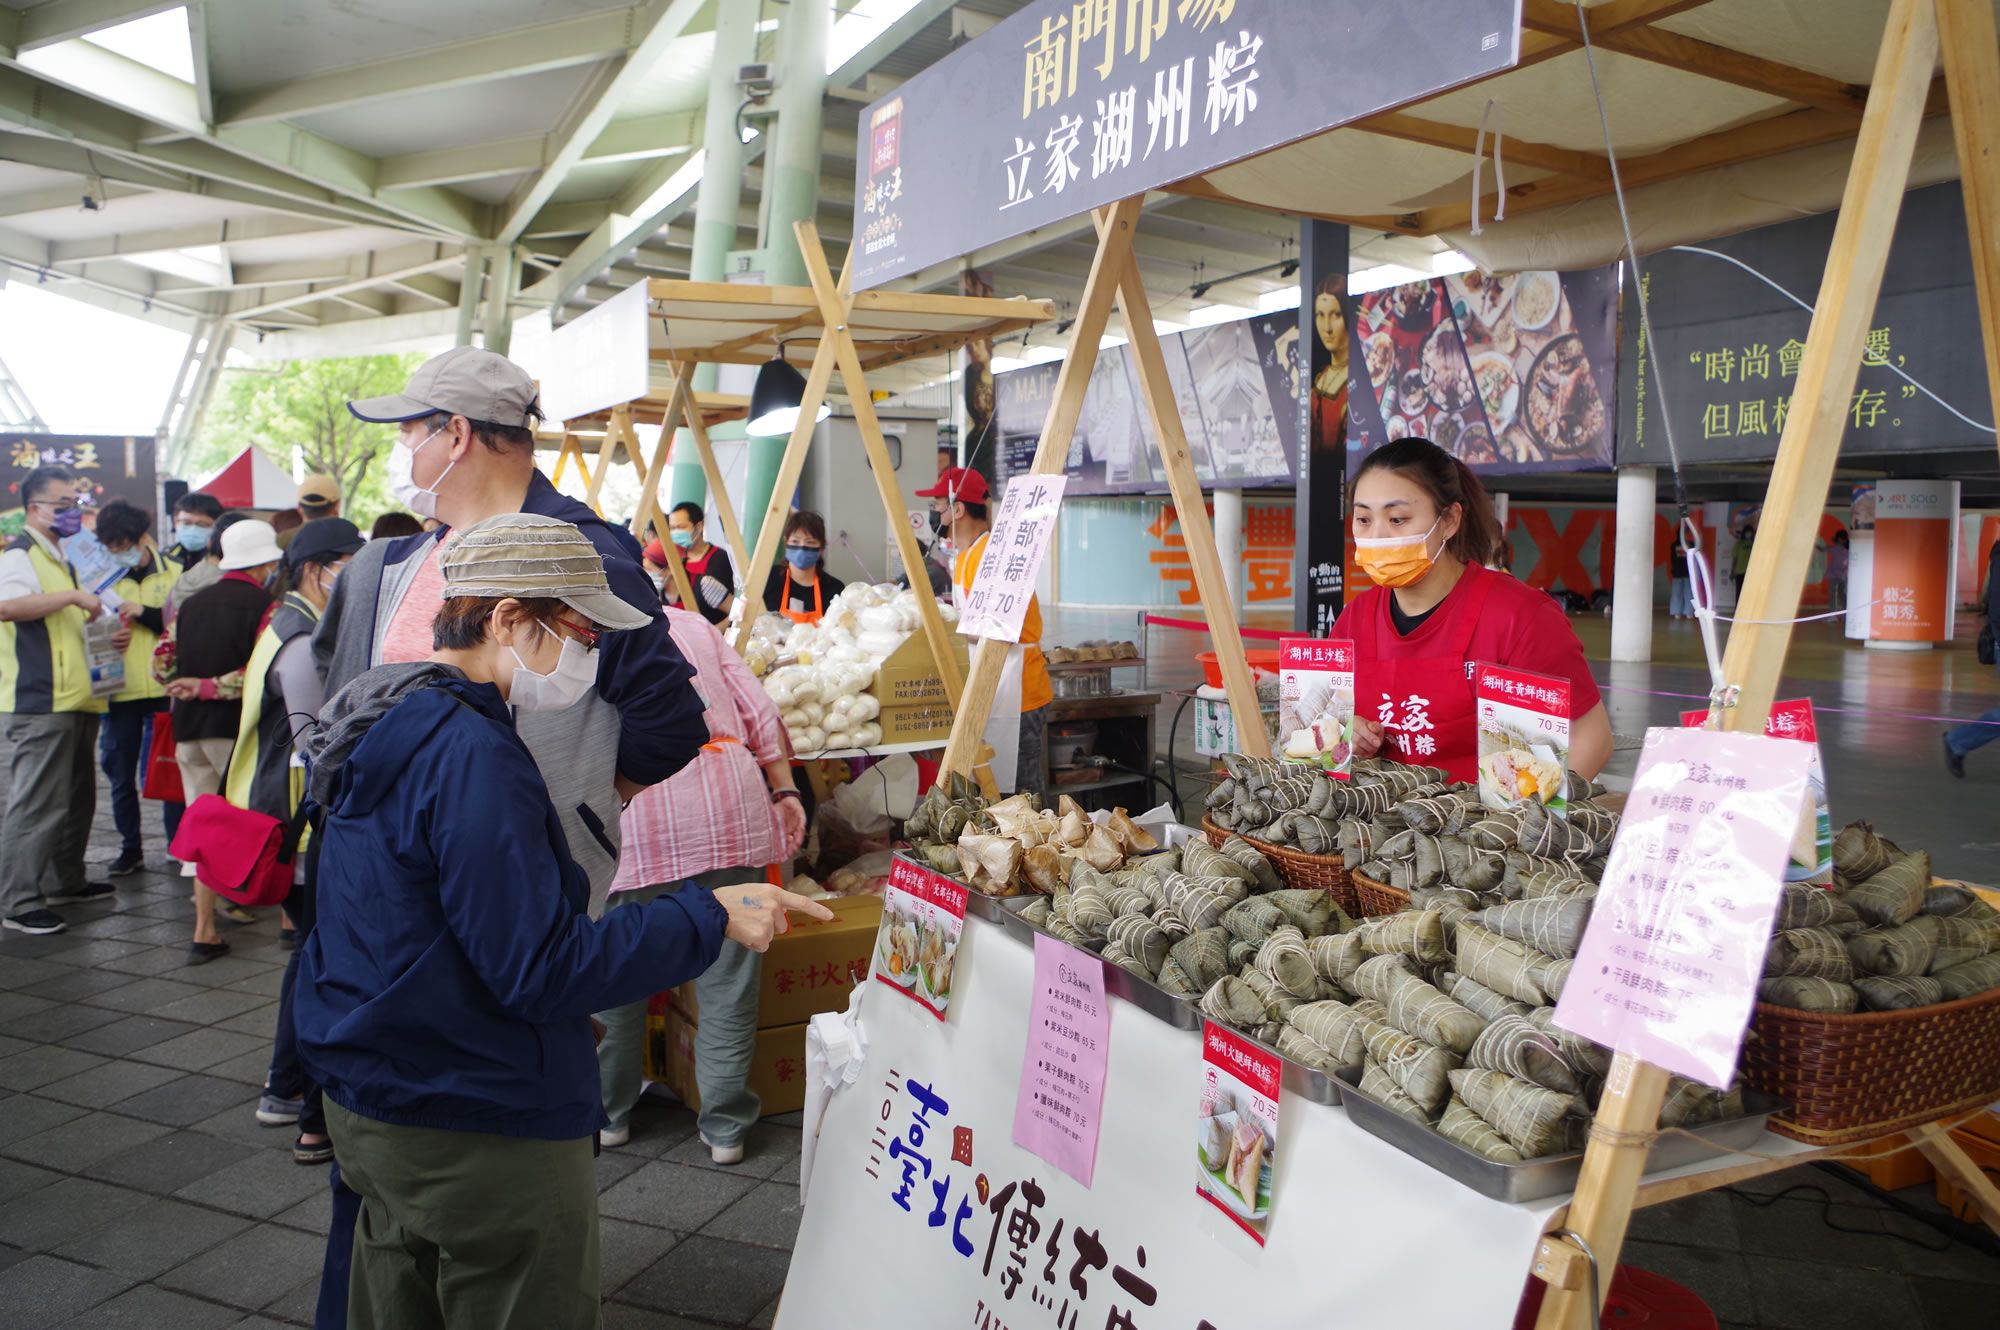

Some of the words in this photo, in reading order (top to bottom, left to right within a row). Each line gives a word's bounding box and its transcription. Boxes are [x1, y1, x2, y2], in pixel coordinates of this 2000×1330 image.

[999, 31, 1263, 211] 立家湖州粽
[1004, 485, 1048, 582] 北部粽
[969, 590, 985, 610] 70
[995, 593, 1015, 614] 70
[1289, 646, 1346, 663] 湖州豆沙粽
[1331, 676, 1342, 686] 60
[1344, 676, 1353, 688] 元
[1483, 675, 1561, 704] 湖州蛋黃鮮肉粽
[1377, 692, 1435, 733] 立家
[1538, 717, 1553, 731] 70
[1555, 721, 1568, 735] 元
[1385, 733, 1437, 756] 州粽
[1208, 1034, 1273, 1084] 湖州火腿鮮肉粽
[1252, 1095, 1265, 1113] 70
[1266, 1105, 1278, 1122] 元
